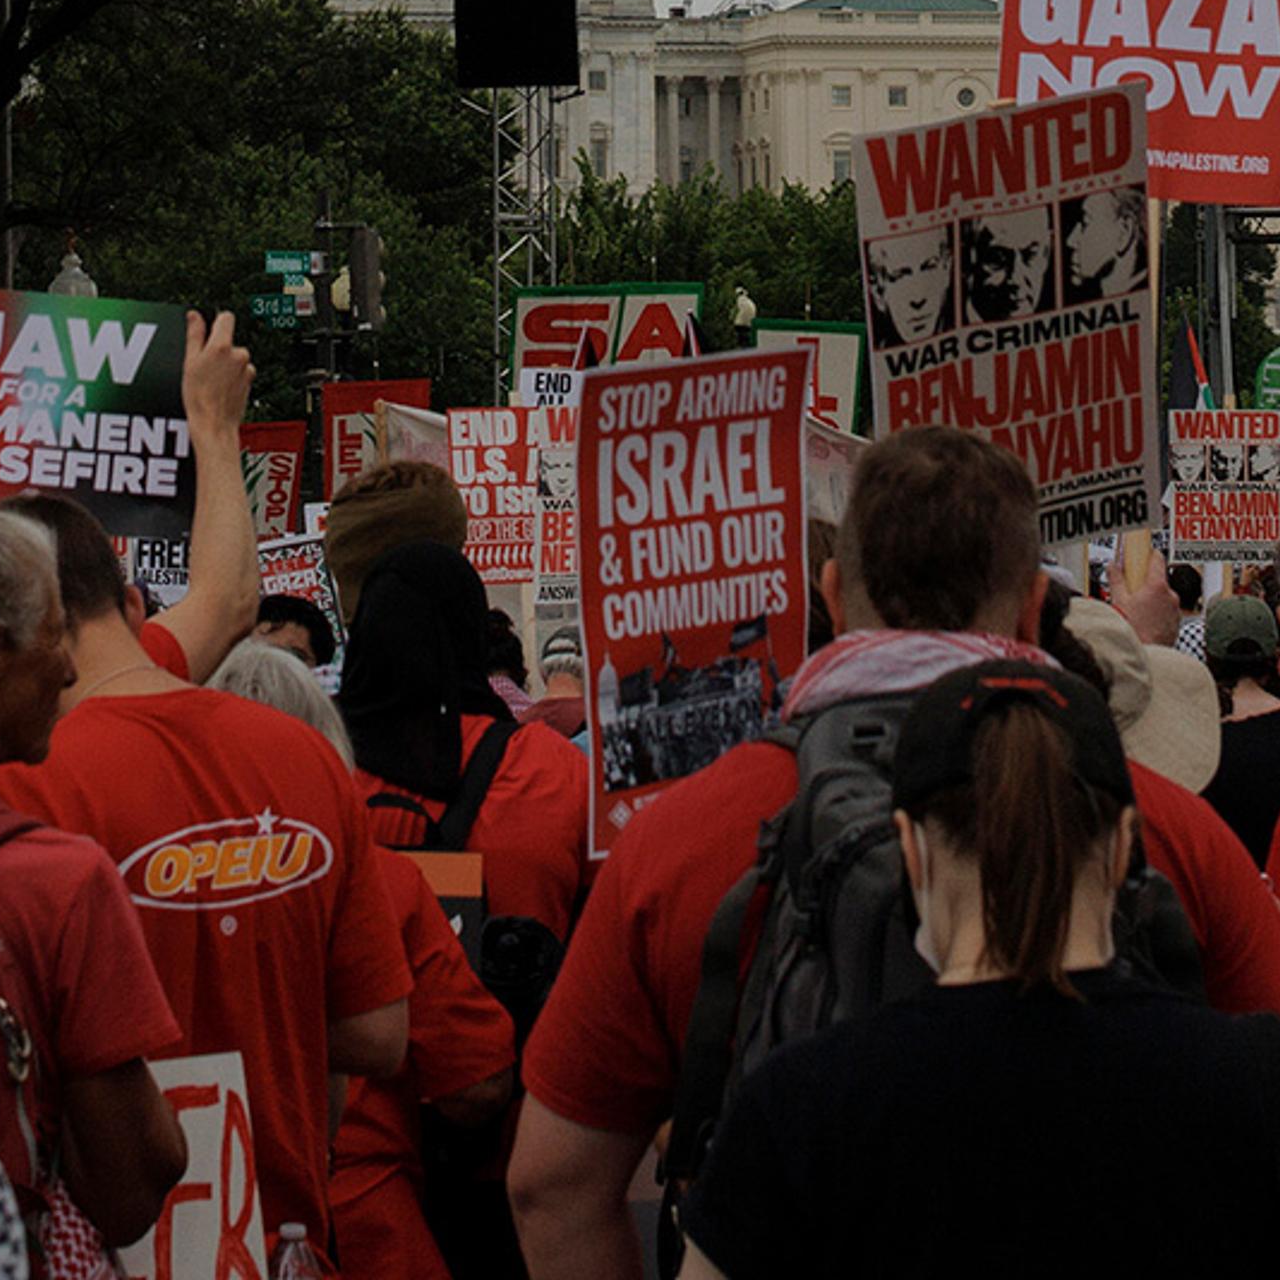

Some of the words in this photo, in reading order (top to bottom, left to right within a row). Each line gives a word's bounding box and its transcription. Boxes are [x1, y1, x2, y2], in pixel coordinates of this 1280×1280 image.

[865, 91, 1133, 220] WANTED
[885, 324, 960, 378] WAR
[966, 300, 1140, 355] CRIMINAL
[63, 383, 88, 407] A
[535, 372, 572, 394] END
[597, 380, 670, 434] STOP
[675, 364, 786, 424] ARMING
[887, 322, 1142, 430] BENJAMIN
[449, 409, 519, 447] END
[1174, 411, 1280, 440] WANTED
[265, 454, 293, 523] STOP
[451, 447, 516, 485] U.S.
[598, 415, 786, 529] ISRAEL
[1056, 464, 1145, 493] HUMANITY
[1173, 491, 1280, 517] BENJAMIN
[1173, 516, 1280, 541] NETANYAHU
[596, 536, 625, 588] &
[631, 521, 714, 581] FUND
[720, 510, 787, 571] OUR
[262, 570, 317, 596] GAZA
[602, 566, 790, 641] COMMUNITIES
[143, 830, 317, 900] OPEIU
